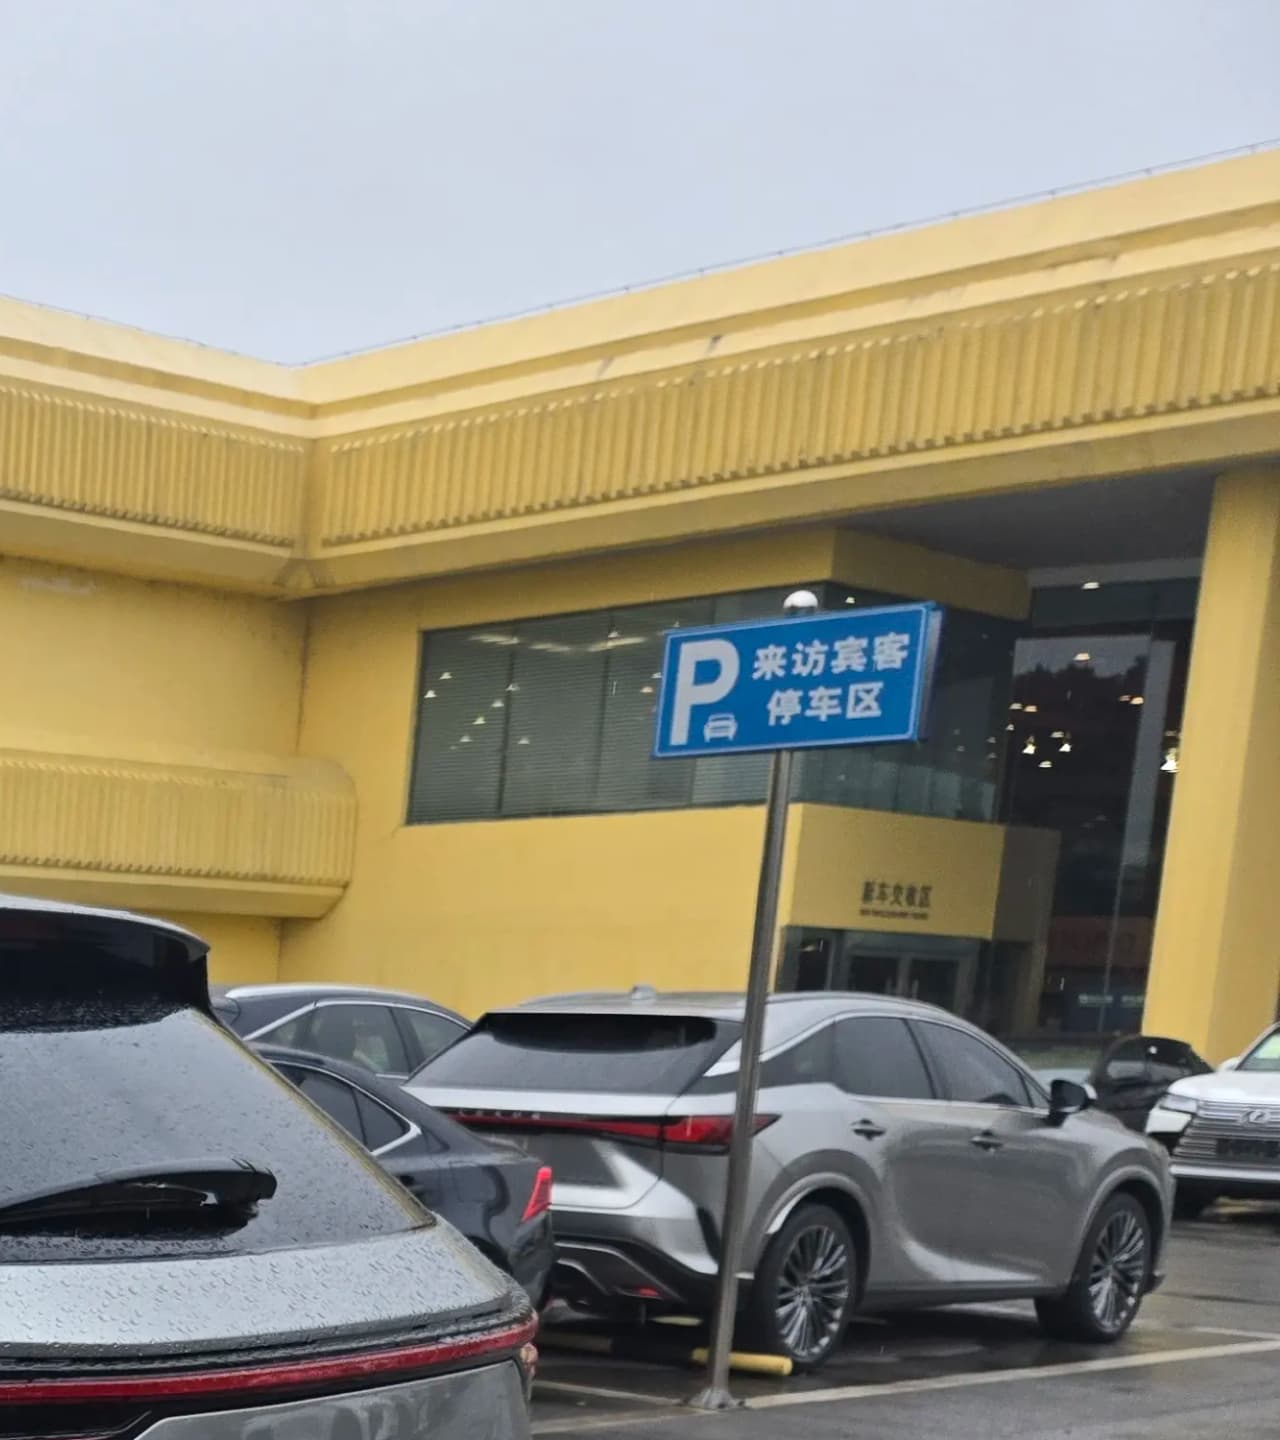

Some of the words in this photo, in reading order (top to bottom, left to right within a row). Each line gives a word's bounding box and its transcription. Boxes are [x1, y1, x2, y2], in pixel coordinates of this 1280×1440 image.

[751, 631, 911, 681] 来访宾客
[669, 638, 740, 746] P
[766, 681, 884, 727] 停车区
